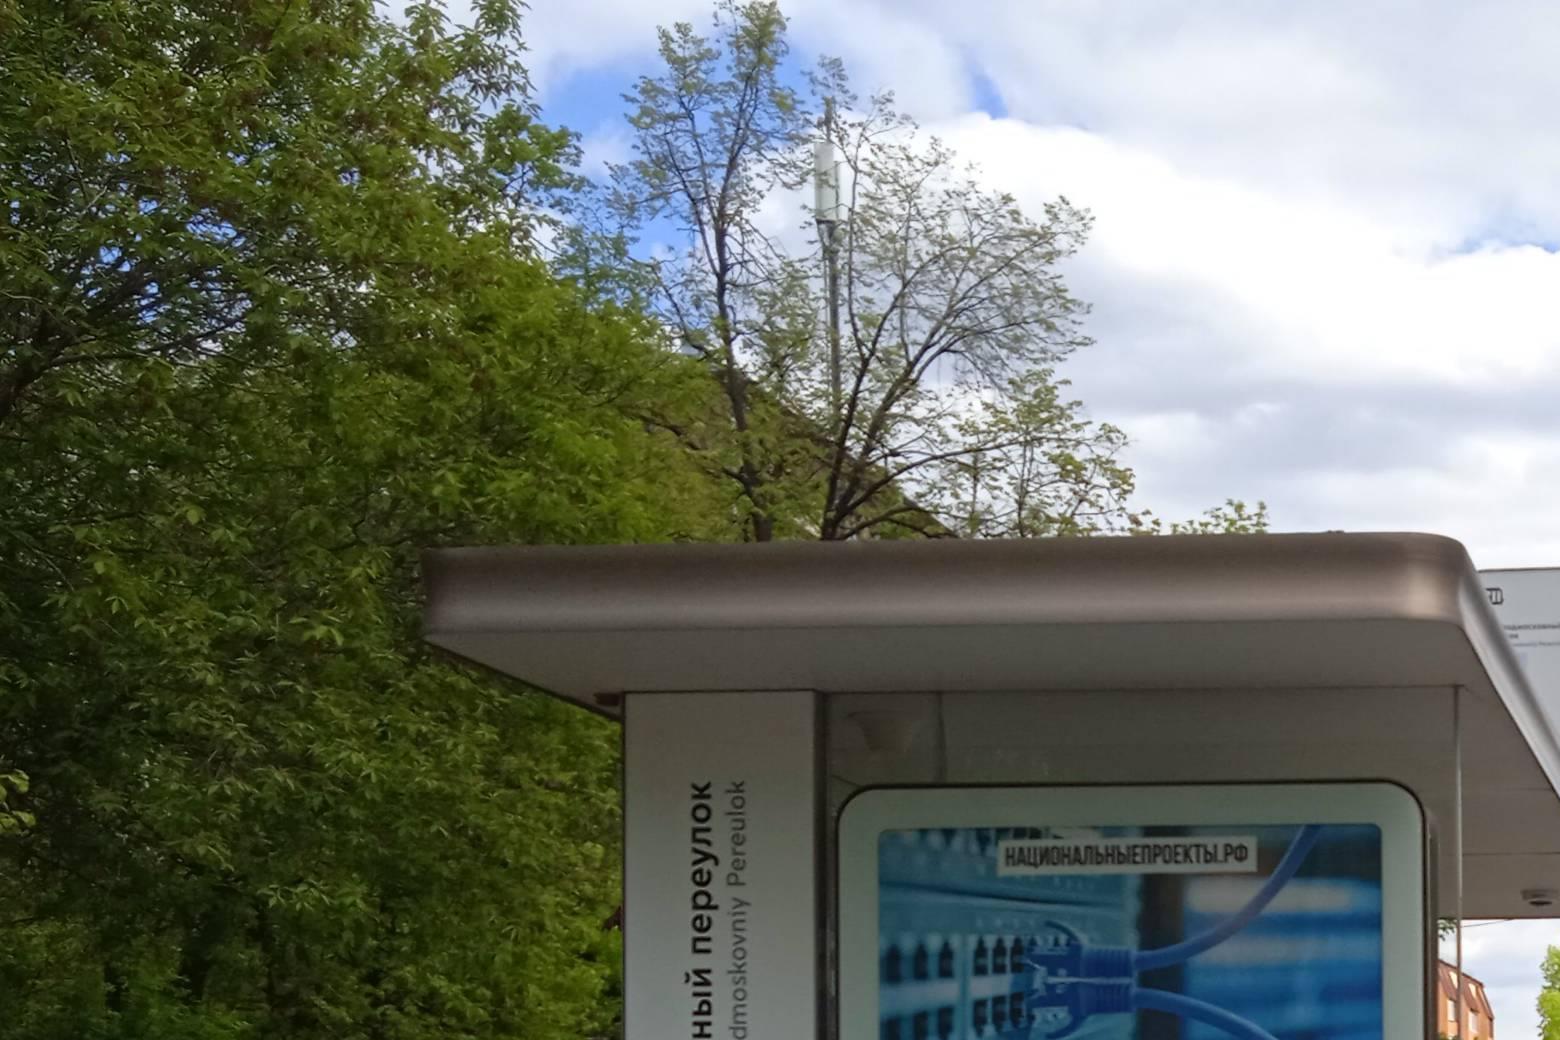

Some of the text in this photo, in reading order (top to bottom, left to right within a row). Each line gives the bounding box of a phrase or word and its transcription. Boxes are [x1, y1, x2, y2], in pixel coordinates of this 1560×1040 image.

[690, 781, 719, 955] переулок
[724, 780, 747, 886] Pereulok
[1005, 843, 1248, 868] НАЦИОНАЛЬНЫЕПРОЕКТЫ.РФ
